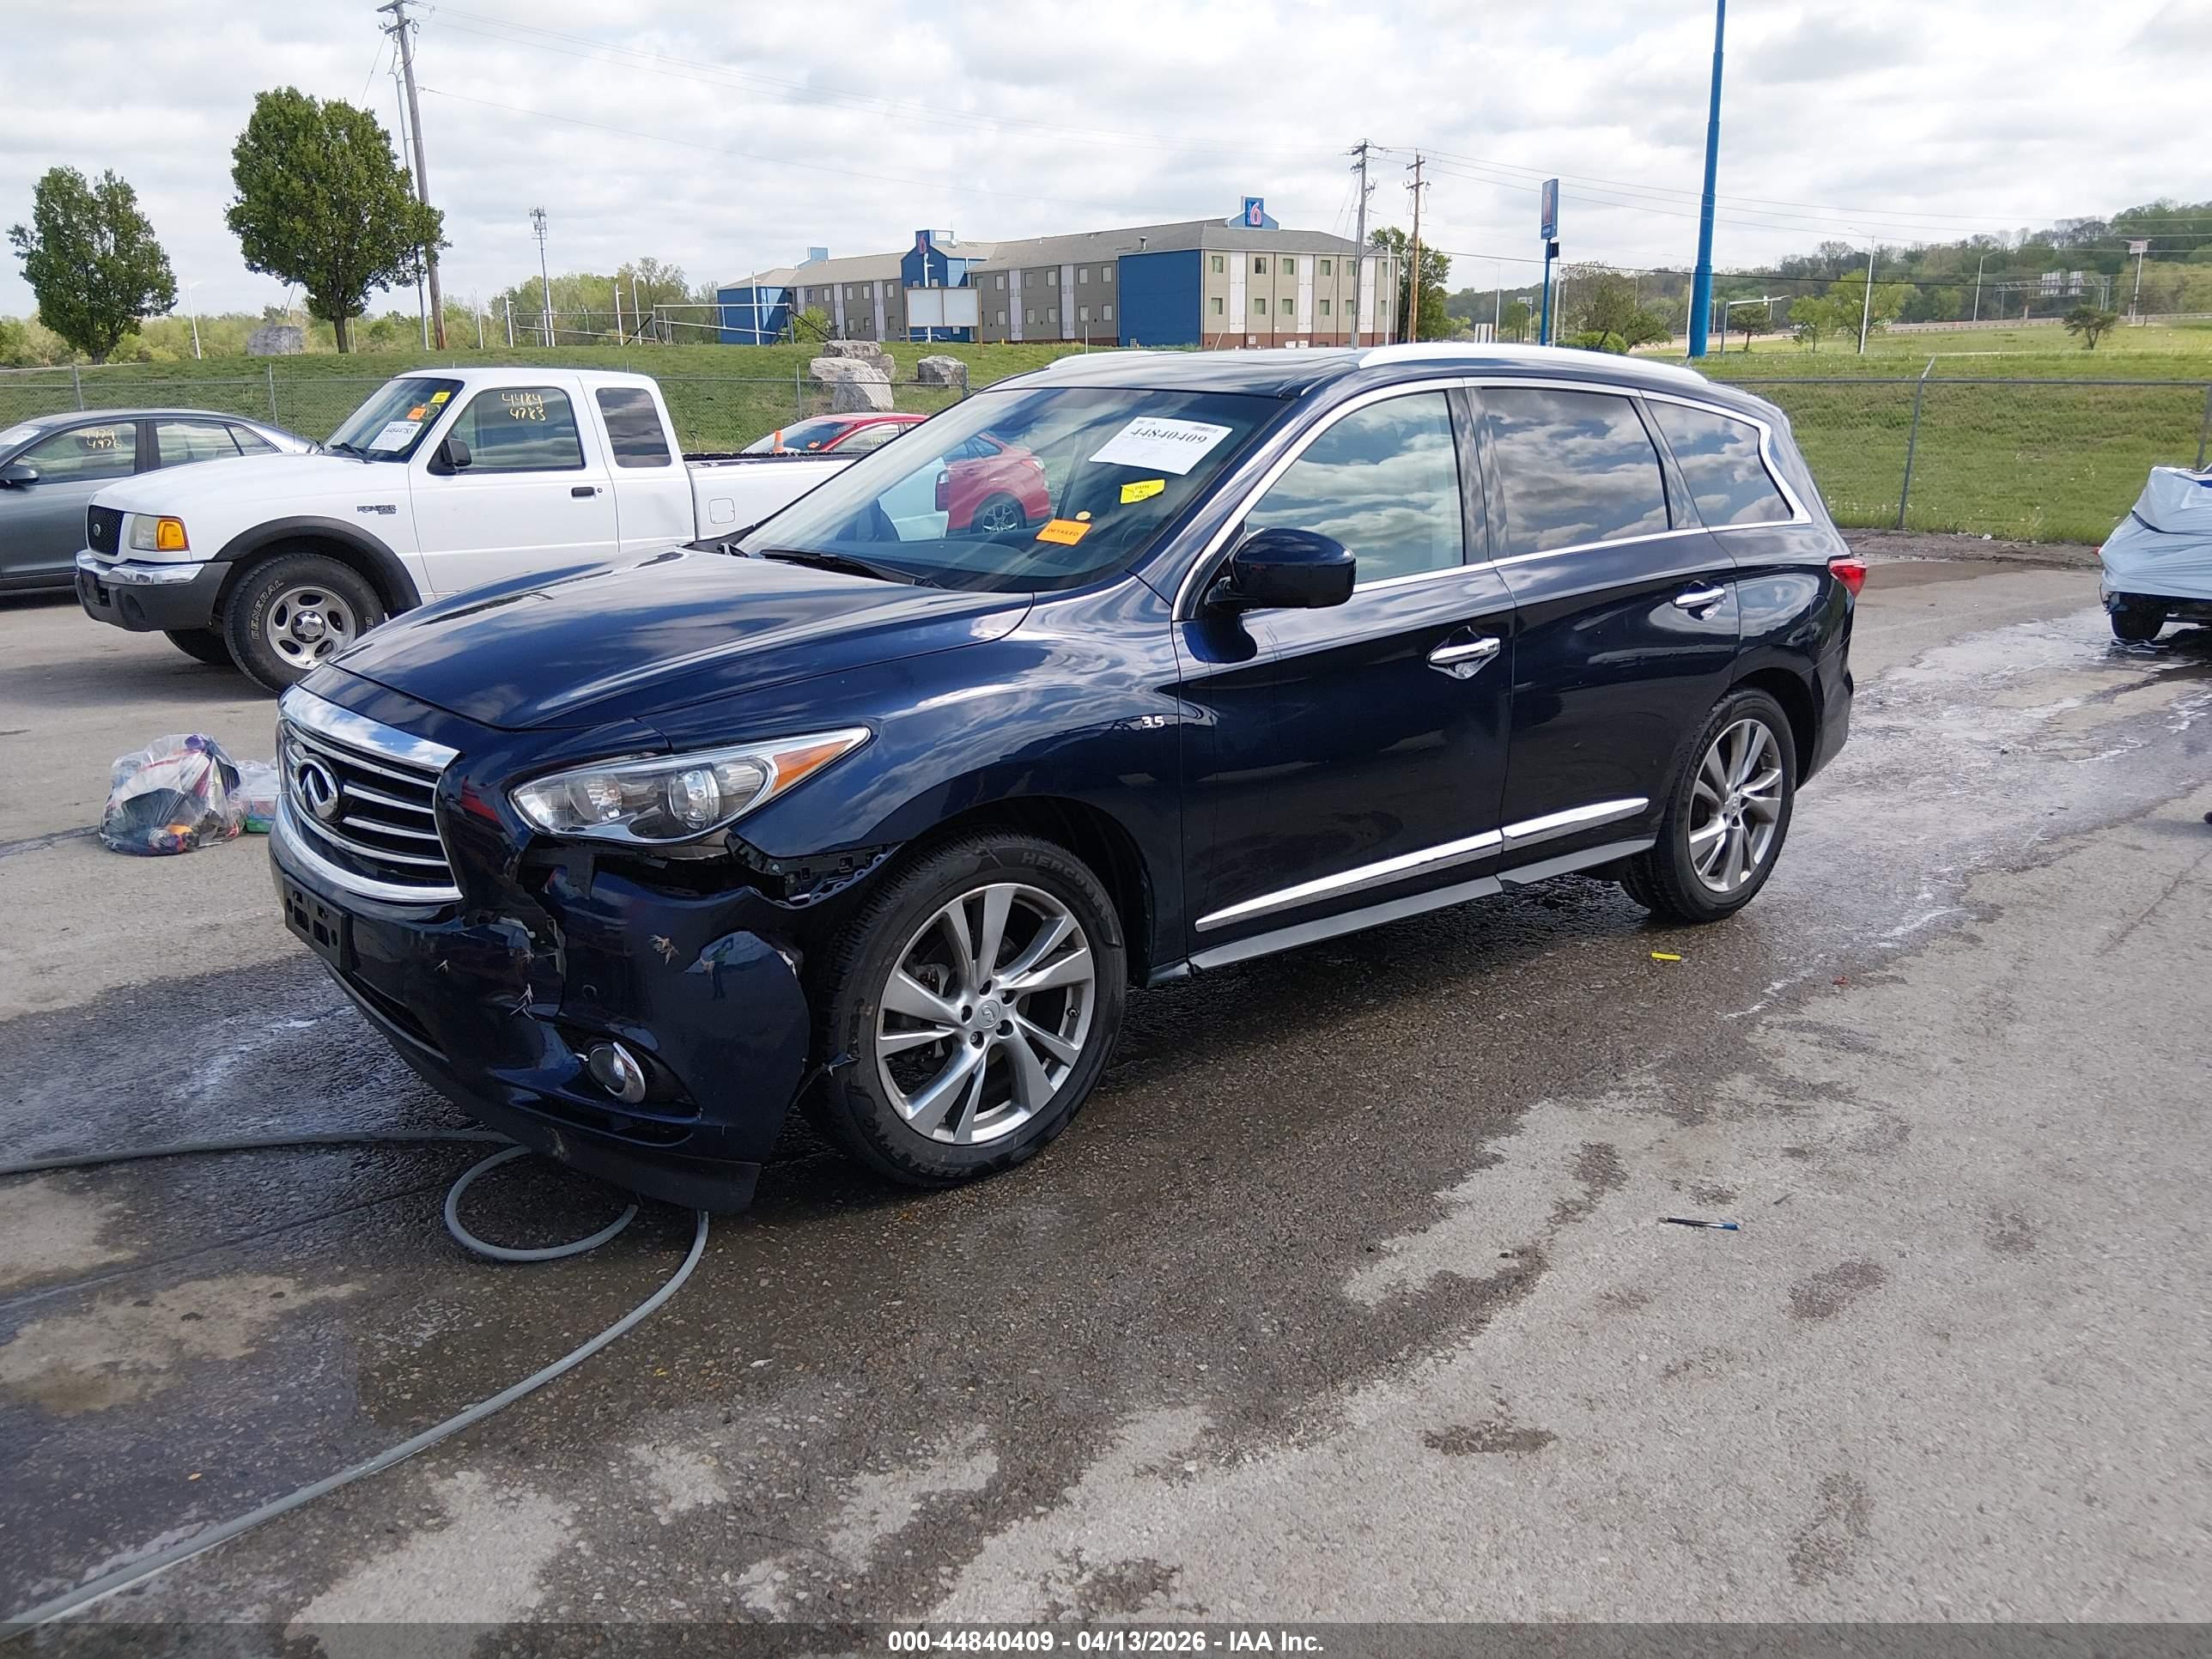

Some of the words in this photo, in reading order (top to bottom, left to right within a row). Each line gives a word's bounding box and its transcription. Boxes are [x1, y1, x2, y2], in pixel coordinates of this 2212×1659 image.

[1250, 202, 1261, 226] 6
[501, 392, 543, 407] 4484
[509, 406, 546, 421] 4783
[1130, 427, 1208, 444] 44840409
[86, 439, 122, 449] 4976
[250, 580, 285, 640] GENERAL
